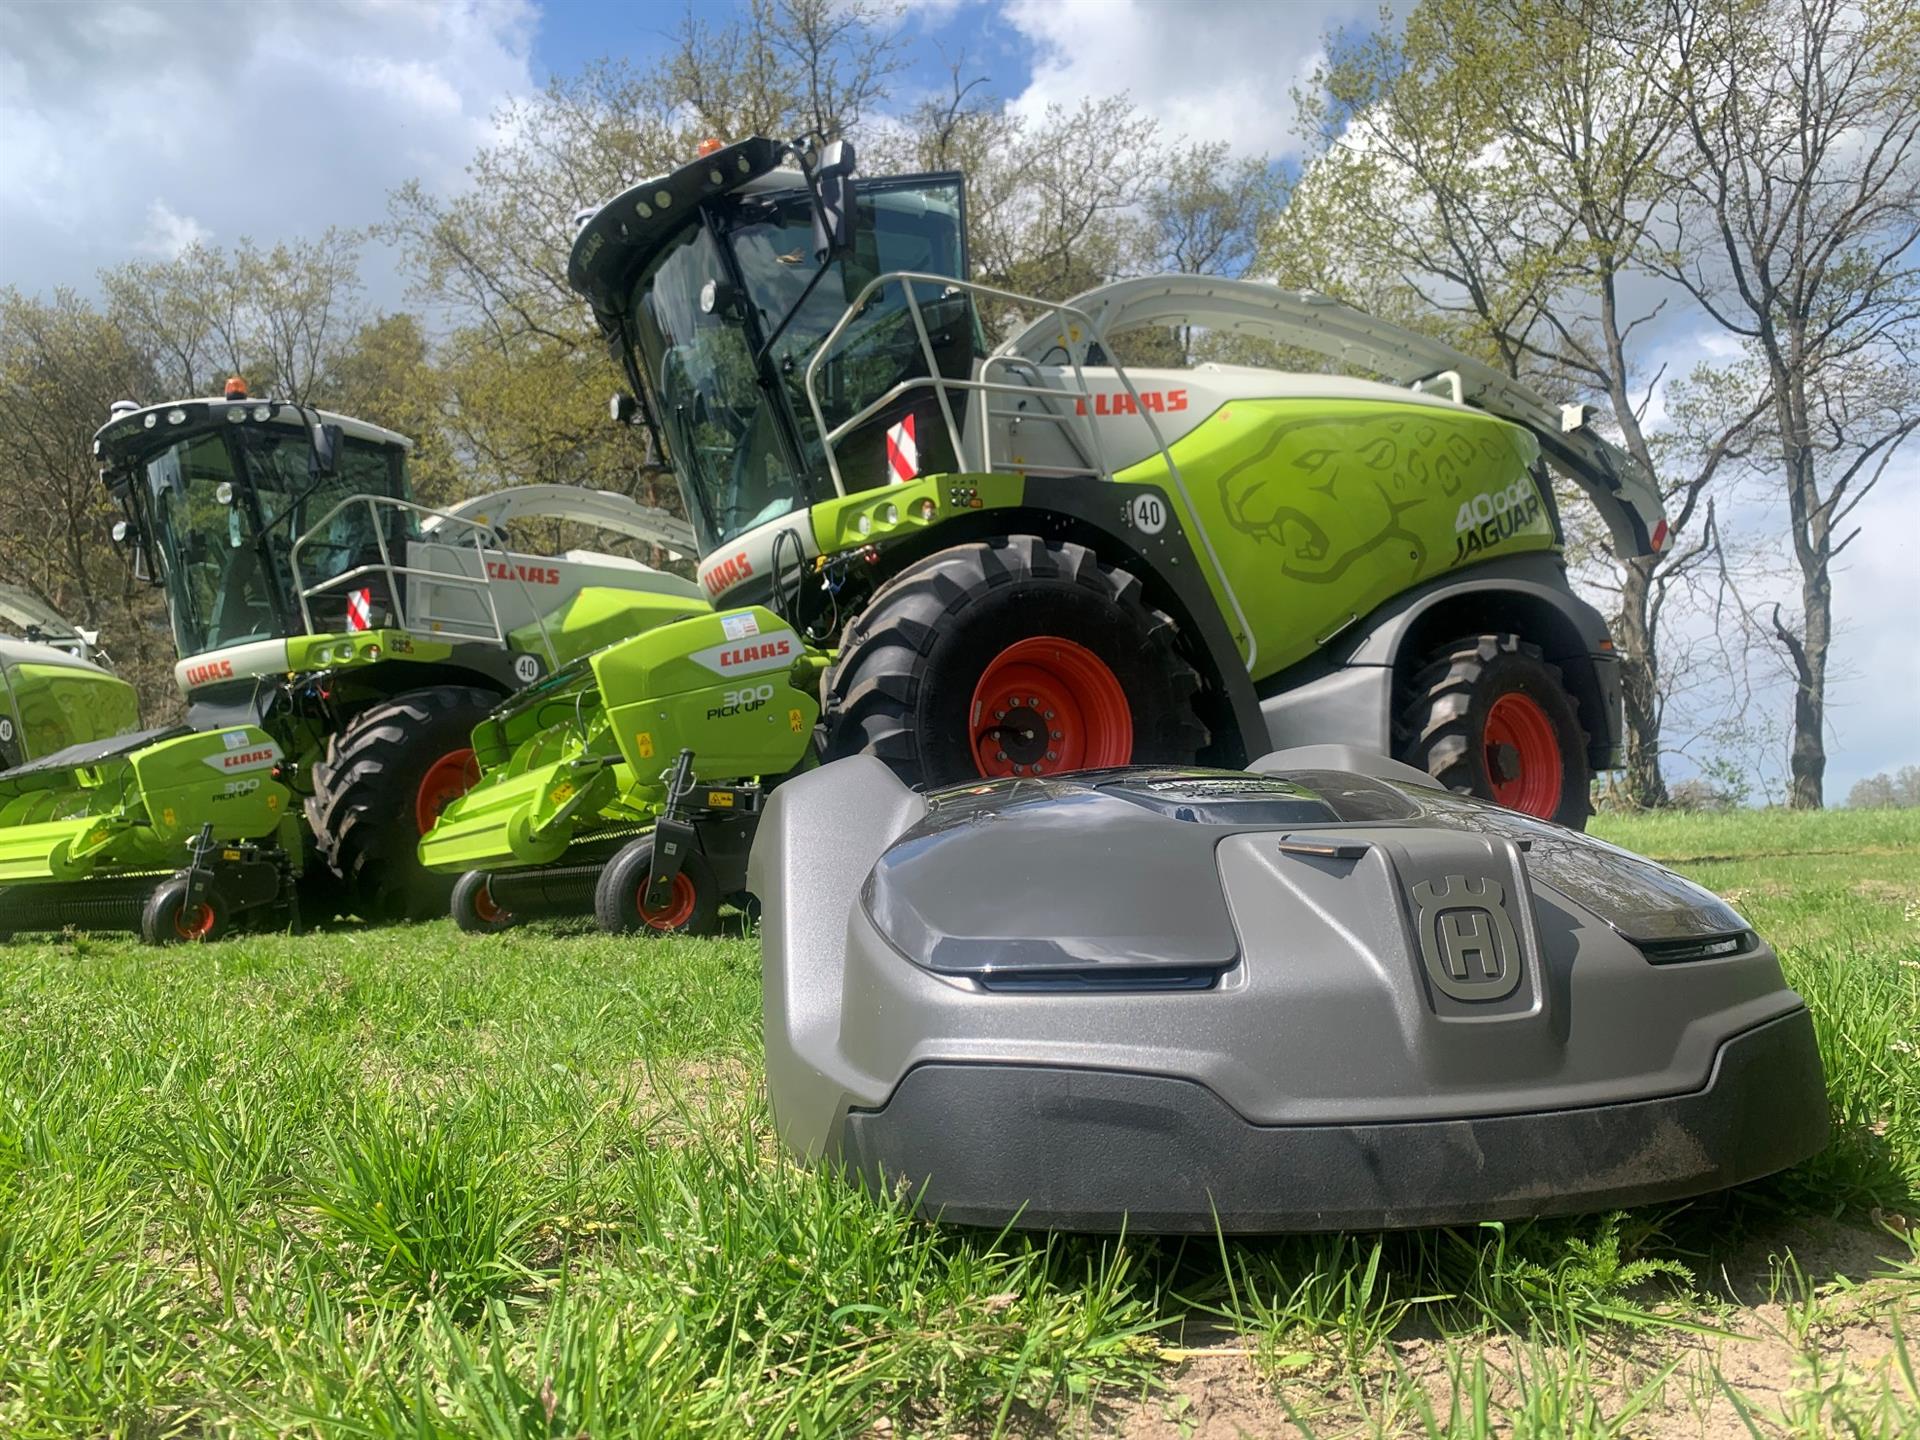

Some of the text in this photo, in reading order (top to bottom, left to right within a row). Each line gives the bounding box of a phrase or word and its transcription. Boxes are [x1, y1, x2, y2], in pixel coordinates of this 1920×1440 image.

[1138, 500, 1160, 526] 40
[1450, 494, 1540, 567] JAGUAR
[486, 561, 560, 585] CLAAS
[704, 551, 754, 597] CLAAS
[720, 640, 790, 667] CLAAS
[186, 659, 234, 686] CLAAS
[519, 659, 535, 677] 40
[723, 684, 774, 708] 300
[706, 698, 766, 721] PICK UP
[223, 748, 273, 769] CLAAS
[223, 778, 261, 795] 300
